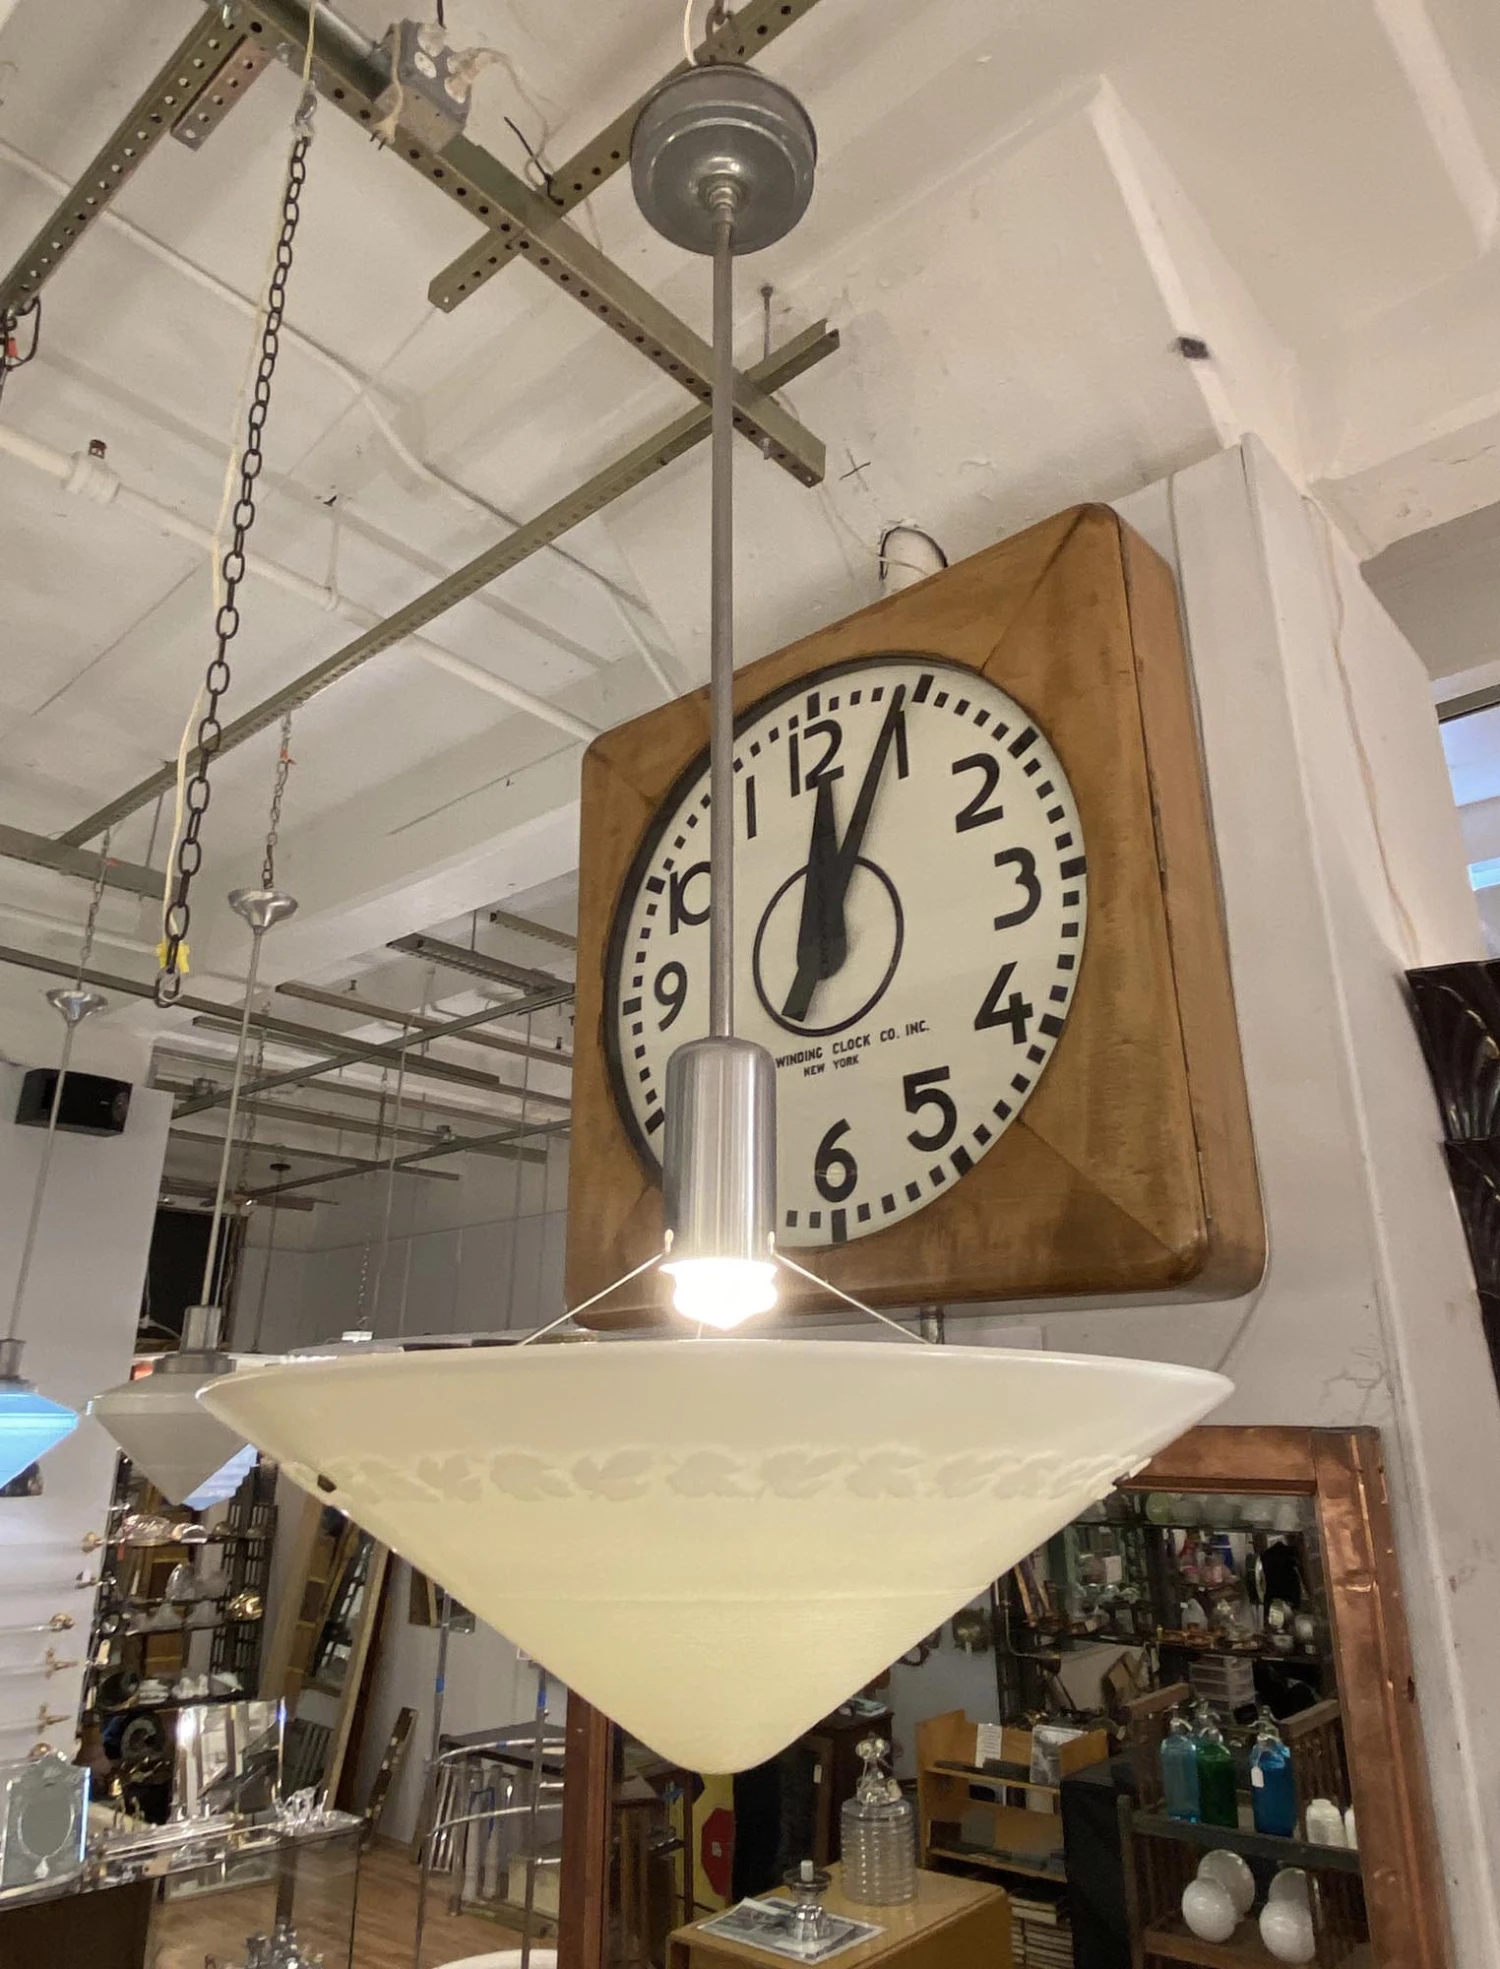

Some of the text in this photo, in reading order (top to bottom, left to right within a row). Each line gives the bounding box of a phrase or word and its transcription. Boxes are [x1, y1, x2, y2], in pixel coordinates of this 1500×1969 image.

[789, 719, 845, 798] 12
[895, 710, 909, 780] 1
[951, 752, 1004, 833] 2
[994, 847, 1041, 931] 3
[654, 961, 688, 1032] 9
[973, 961, 1034, 1045] 4
[775, 1020, 930, 1068] WINDING CLOCK CO. INC.
[803, 1054, 859, 1077] NEW YORK
[902, 1065, 958, 1152] 5
[814, 1118, 858, 1203] 6
